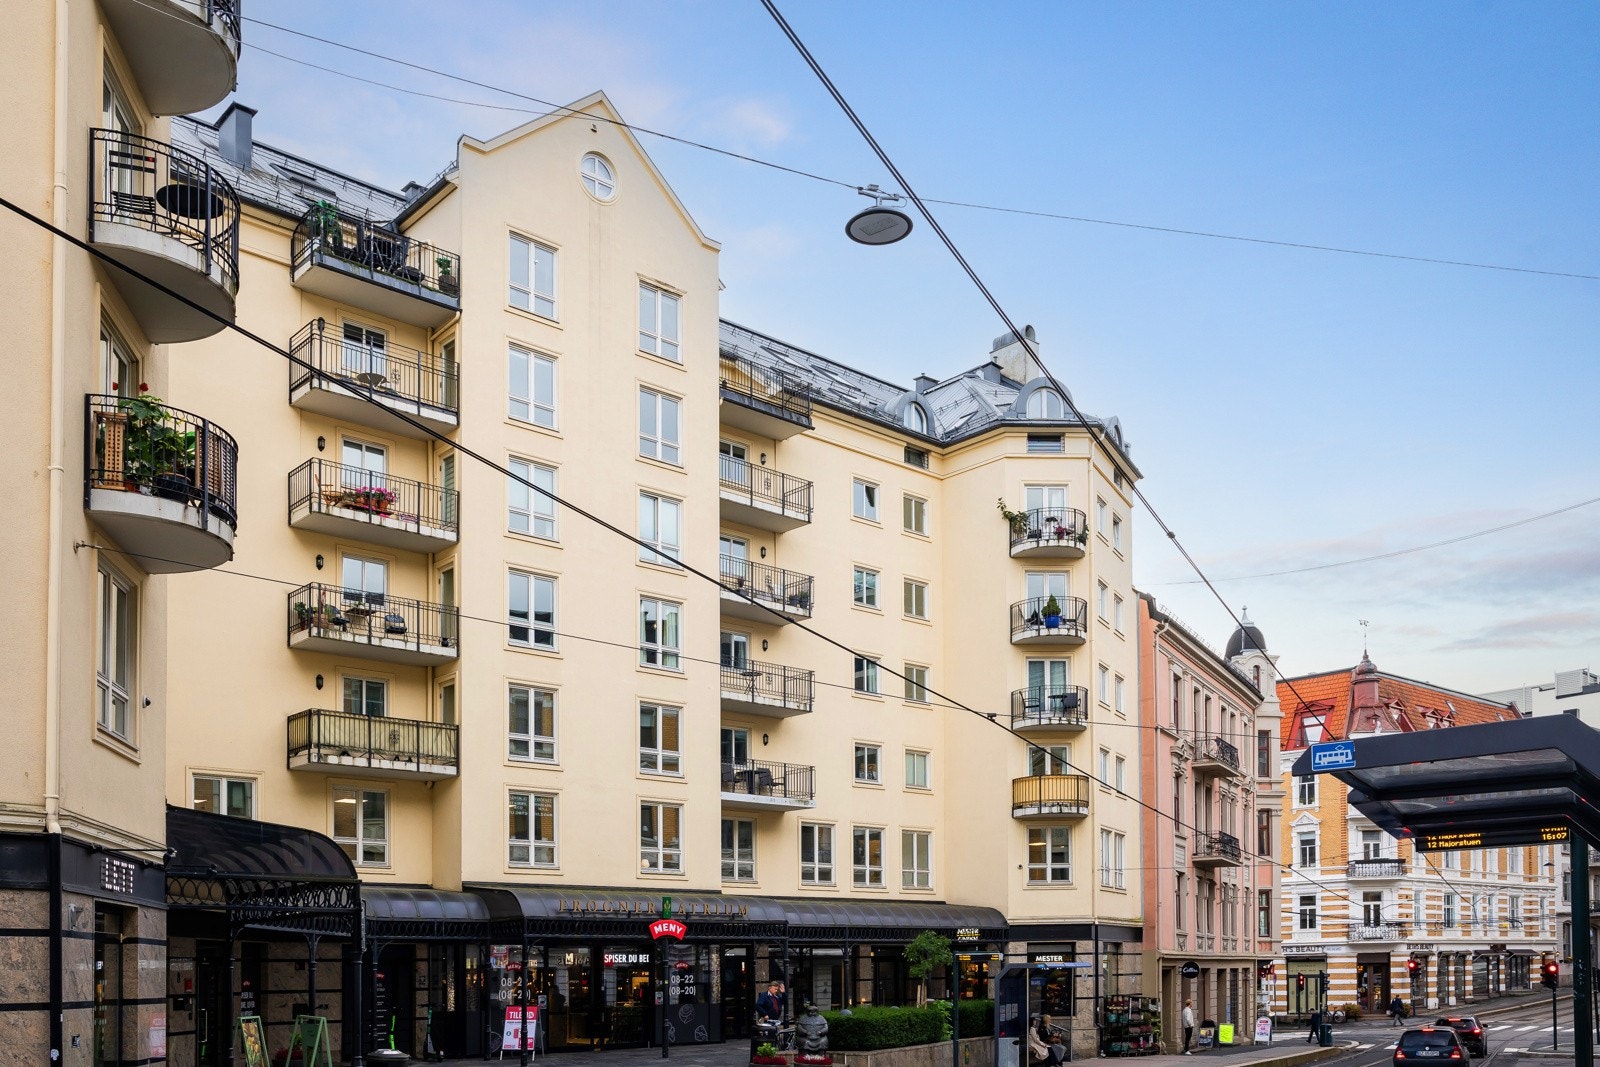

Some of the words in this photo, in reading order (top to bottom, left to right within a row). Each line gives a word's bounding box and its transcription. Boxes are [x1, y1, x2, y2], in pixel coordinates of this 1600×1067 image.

[1438, 839, 1481, 848] Majorstuen
[1542, 832, 1567, 841] 16:07
[559, 899, 656, 914] FROGNER
[677, 903, 750, 917] ATRIUM
[653, 923, 684, 935] MENY
[603, 954, 627, 963] SPISER
[628, 954, 638, 963] DU
[500, 977, 528, 987] 08-2
[668, 986, 696, 996] (08-20)
